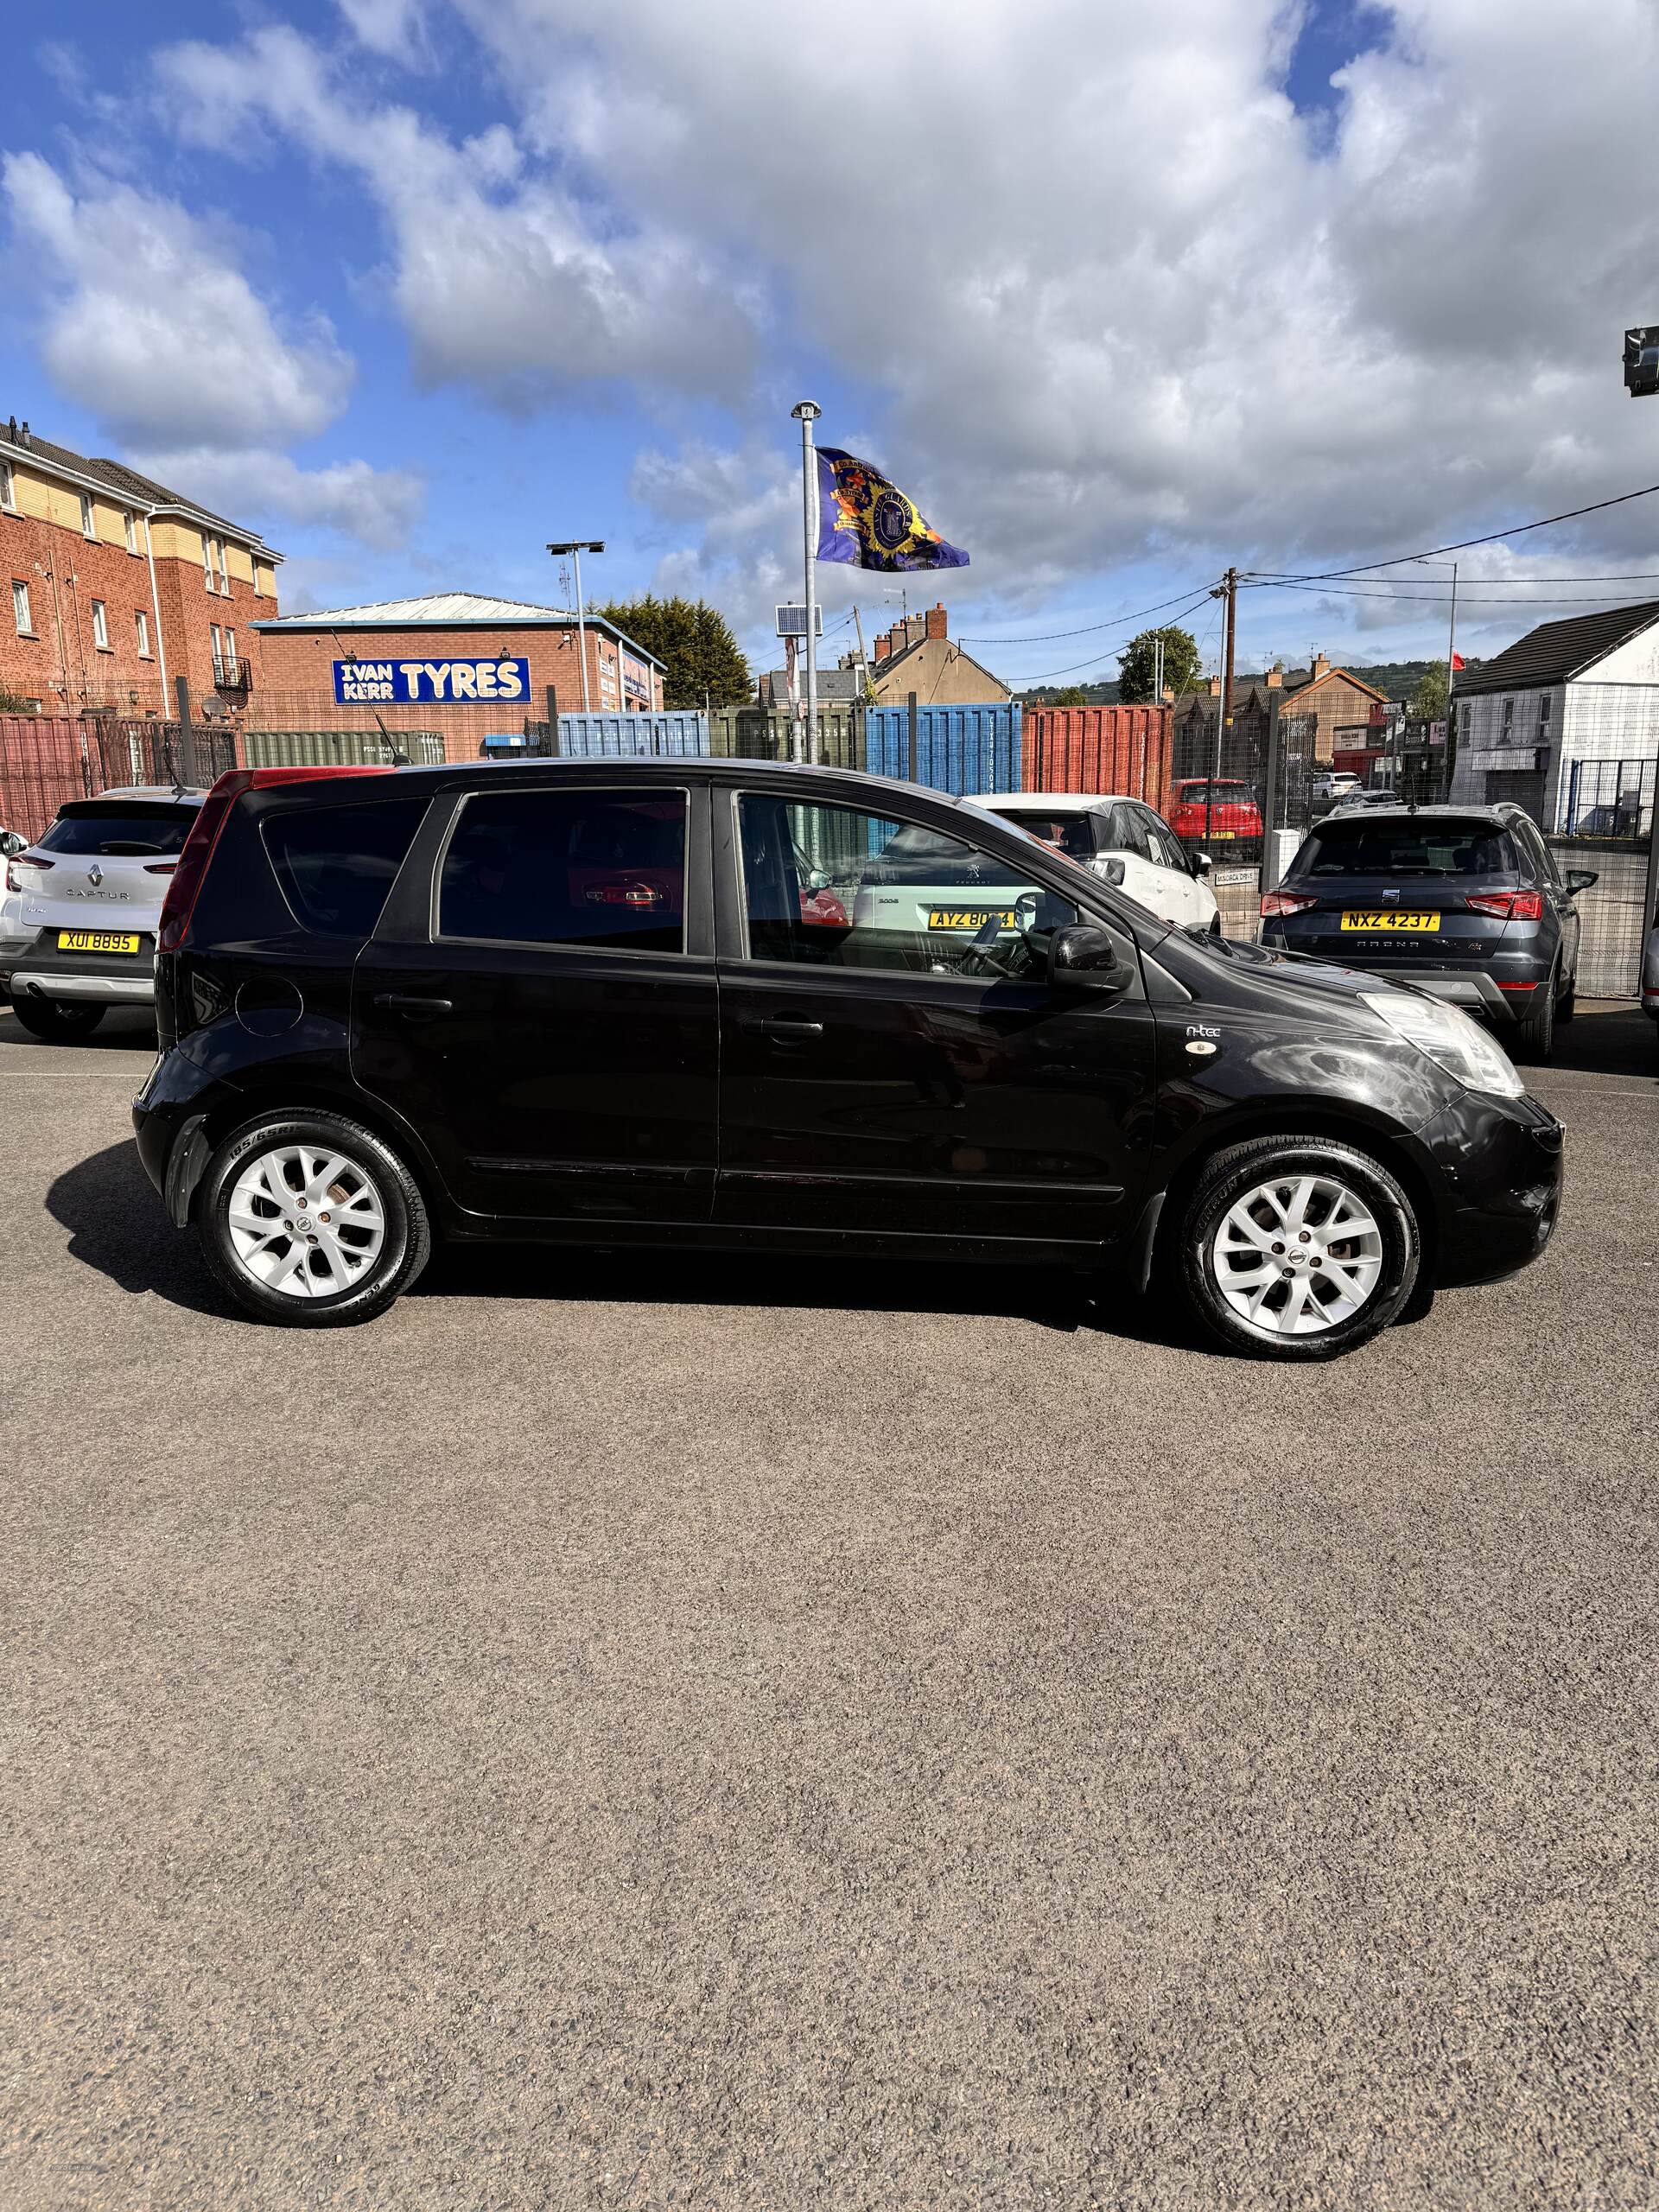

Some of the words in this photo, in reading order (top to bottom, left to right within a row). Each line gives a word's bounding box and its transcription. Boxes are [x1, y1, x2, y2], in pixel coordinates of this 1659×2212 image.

[340, 664, 393, 682] IVAN
[399, 662, 523, 699] TYRES
[343, 682, 394, 700] KERR
[66, 889, 130, 899] CAPTUR
[936, 912, 965, 925] AYZ
[969, 912, 1010, 926] 804
[1348, 912, 1382, 927] NXZ
[1387, 913, 1433, 928] 4237
[67, 932, 90, 948] XUI
[92, 934, 130, 950] 8895
[1185, 1024, 1221, 1037] n-tec
